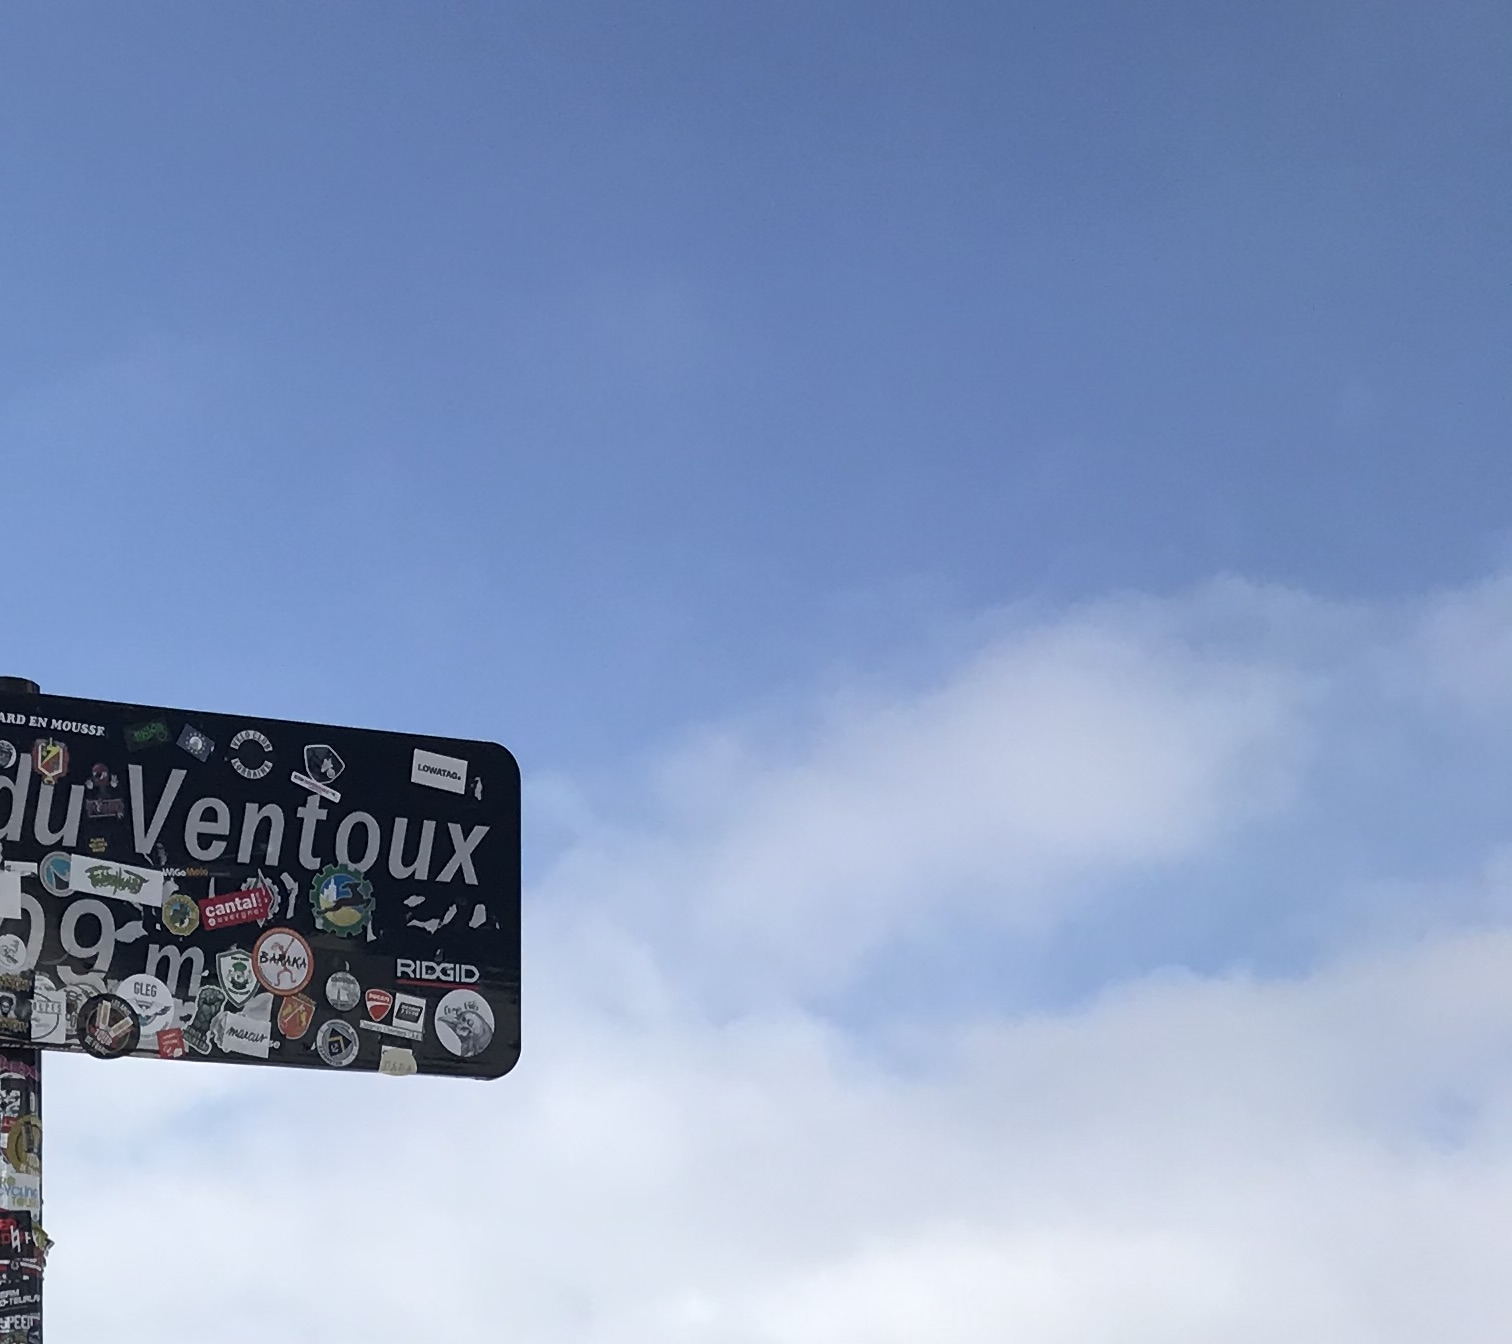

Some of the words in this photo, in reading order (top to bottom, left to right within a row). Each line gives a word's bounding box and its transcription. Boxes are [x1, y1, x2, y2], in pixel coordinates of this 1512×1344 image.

[28, 715, 48, 728] EN
[128, 764, 490, 886] Ventoux
[259, 951, 307, 969] BARAKA
[396, 958, 480, 983] RIDGID
[133, 981, 157, 997] GLEG
